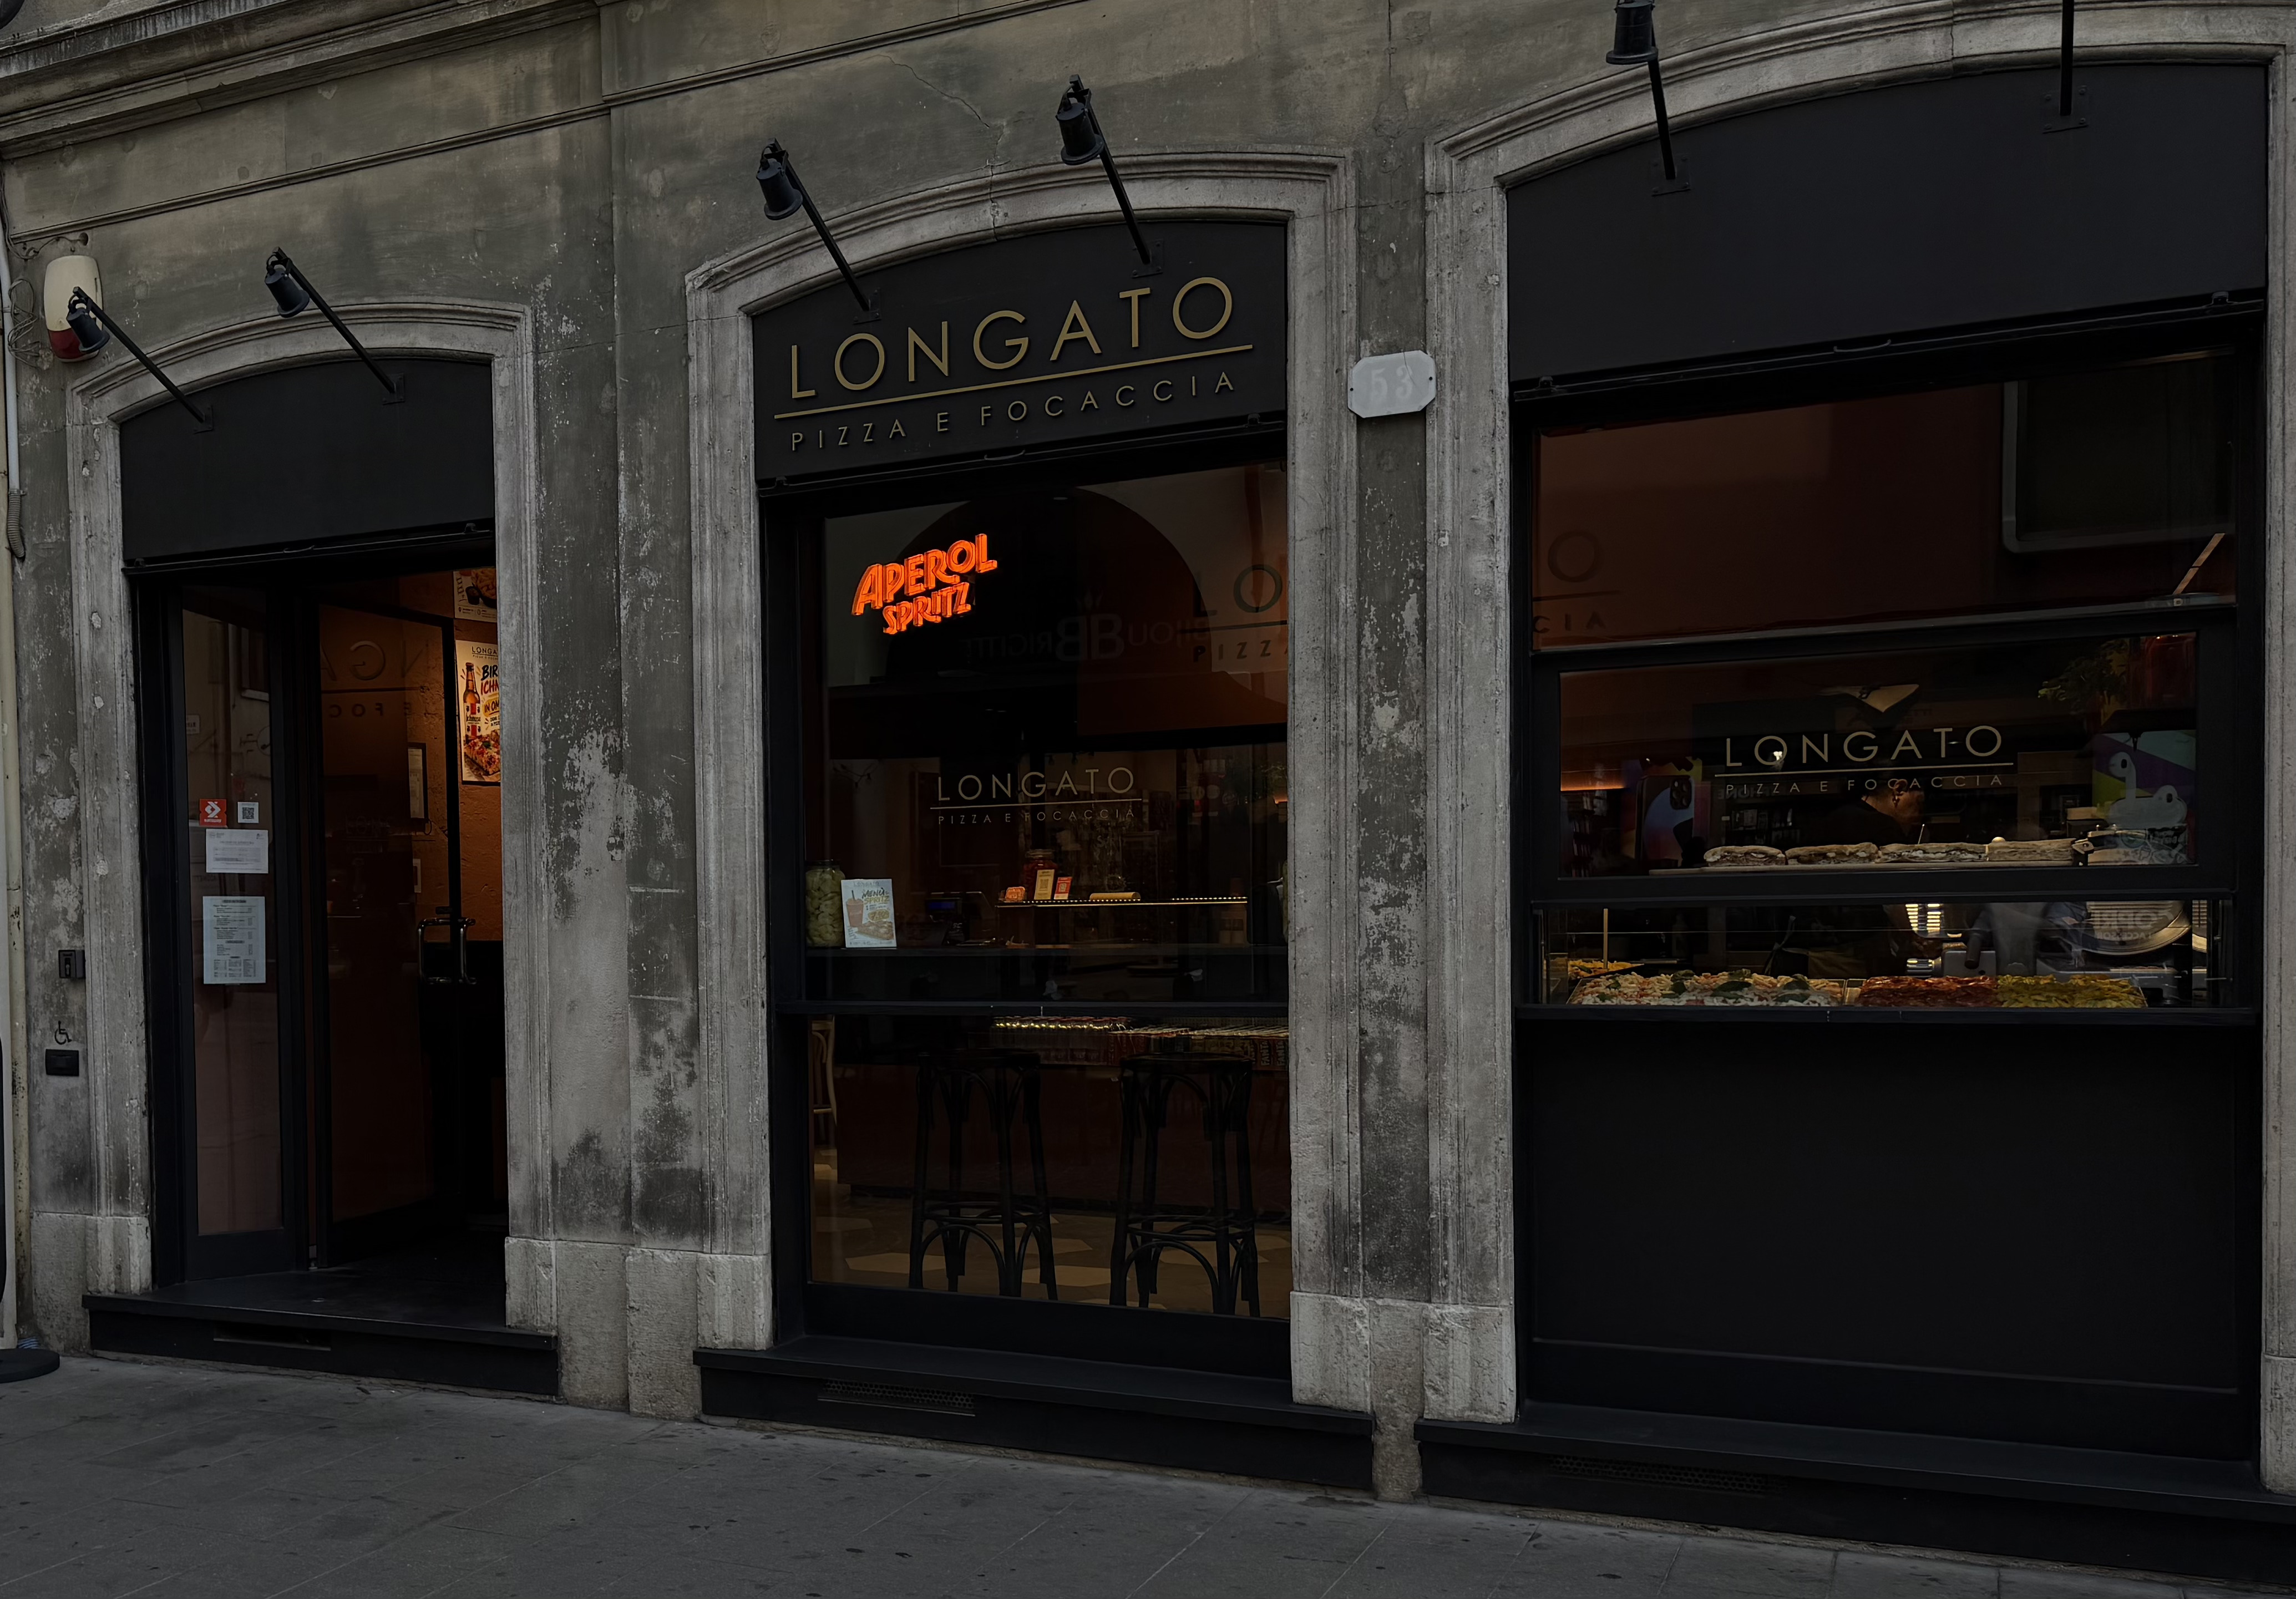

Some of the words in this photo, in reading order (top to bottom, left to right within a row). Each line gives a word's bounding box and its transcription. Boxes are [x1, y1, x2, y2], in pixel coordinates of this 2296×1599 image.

[790, 276, 1233, 399] LONGATO
[1370, 364, 1413, 402] 53
[791, 419, 906, 452] PIZZA
[936, 412, 949, 433] E
[980, 371, 1234, 427] FOCACCIA
[851, 533, 998, 616] APEROL
[882, 582, 971, 635] SPRITZ
[1193, 640, 1288, 662] PIZZ
[1726, 725, 2002, 767] LONGATO
[938, 766, 1134, 801] LONGATO
[1726, 782, 1800, 795] PIZZA
[1820, 780, 1829, 791] E
[1848, 774, 2003, 791] FOCACCIA
[938, 814, 992, 825] PIZZA
[1005, 813, 1011, 822] E
[1024, 809, 1134, 823] FOCACCIA
